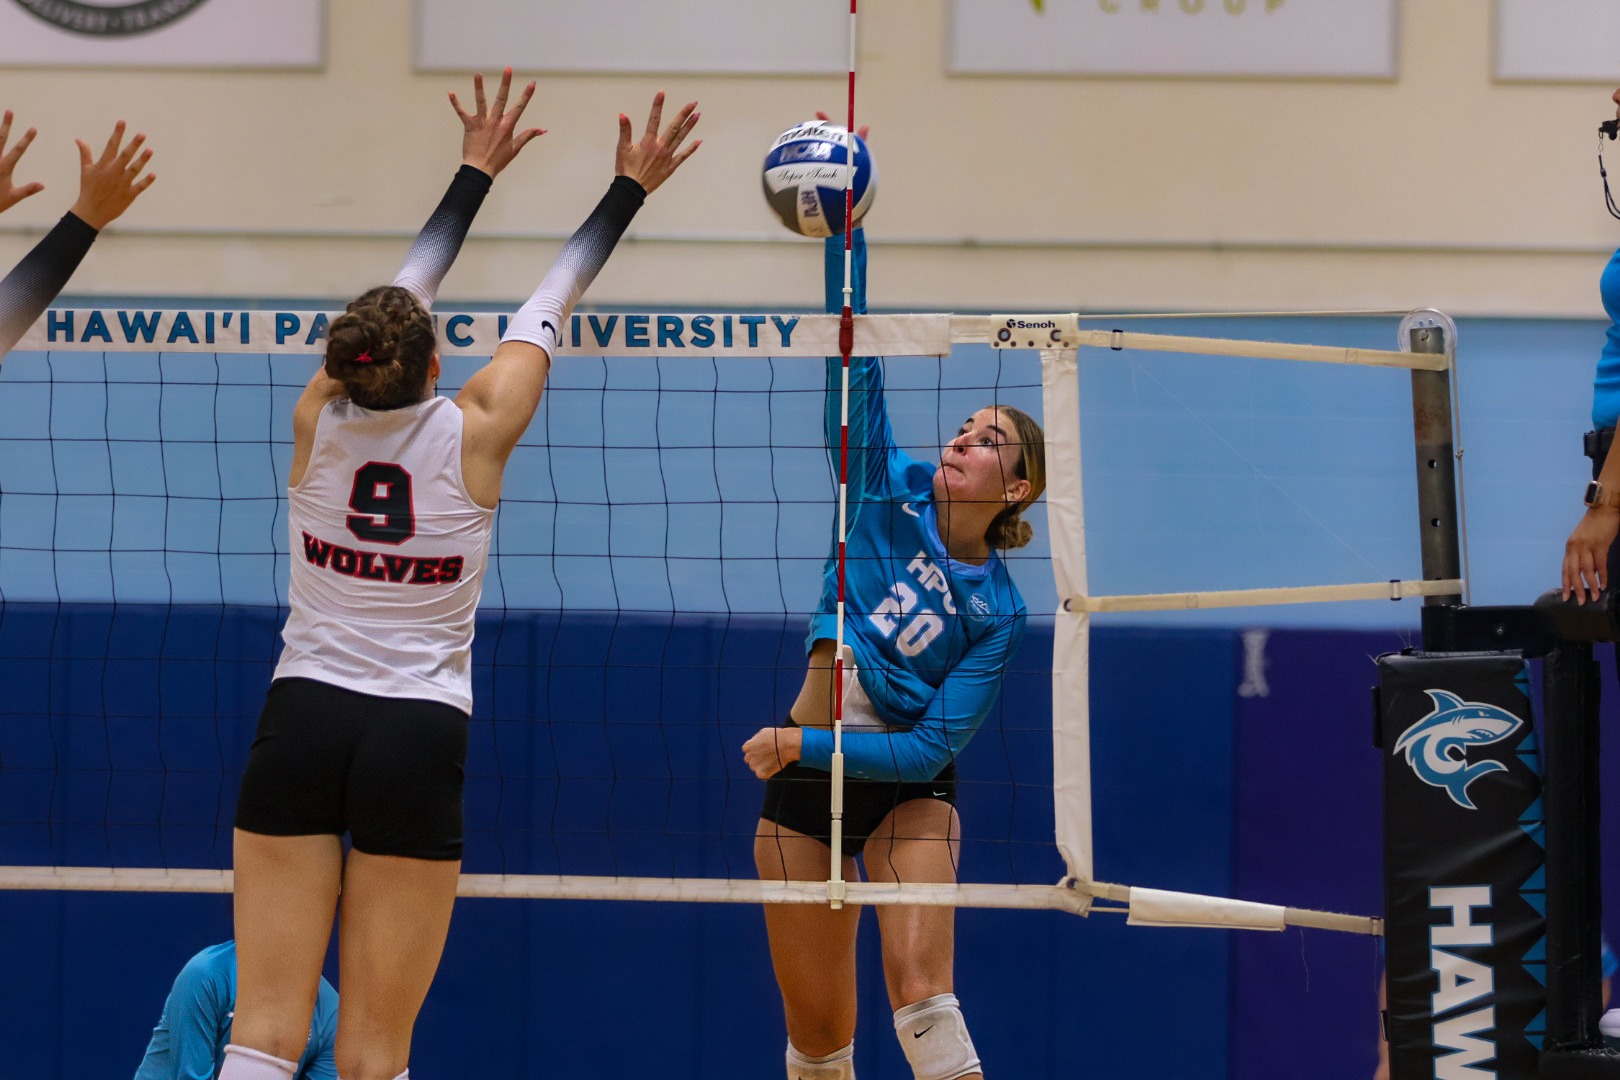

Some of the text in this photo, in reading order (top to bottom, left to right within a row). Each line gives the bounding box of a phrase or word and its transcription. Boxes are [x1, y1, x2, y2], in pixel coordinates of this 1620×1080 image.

[47, 310, 800, 348] HAWAI'I PAIC IVERSITY
[1017, 320, 1056, 329] Senoh
[346, 461, 416, 546] 9
[302, 530, 465, 585] WOLVES
[868, 582, 944, 657] 20
[1428, 884, 1498, 1080] HAW
